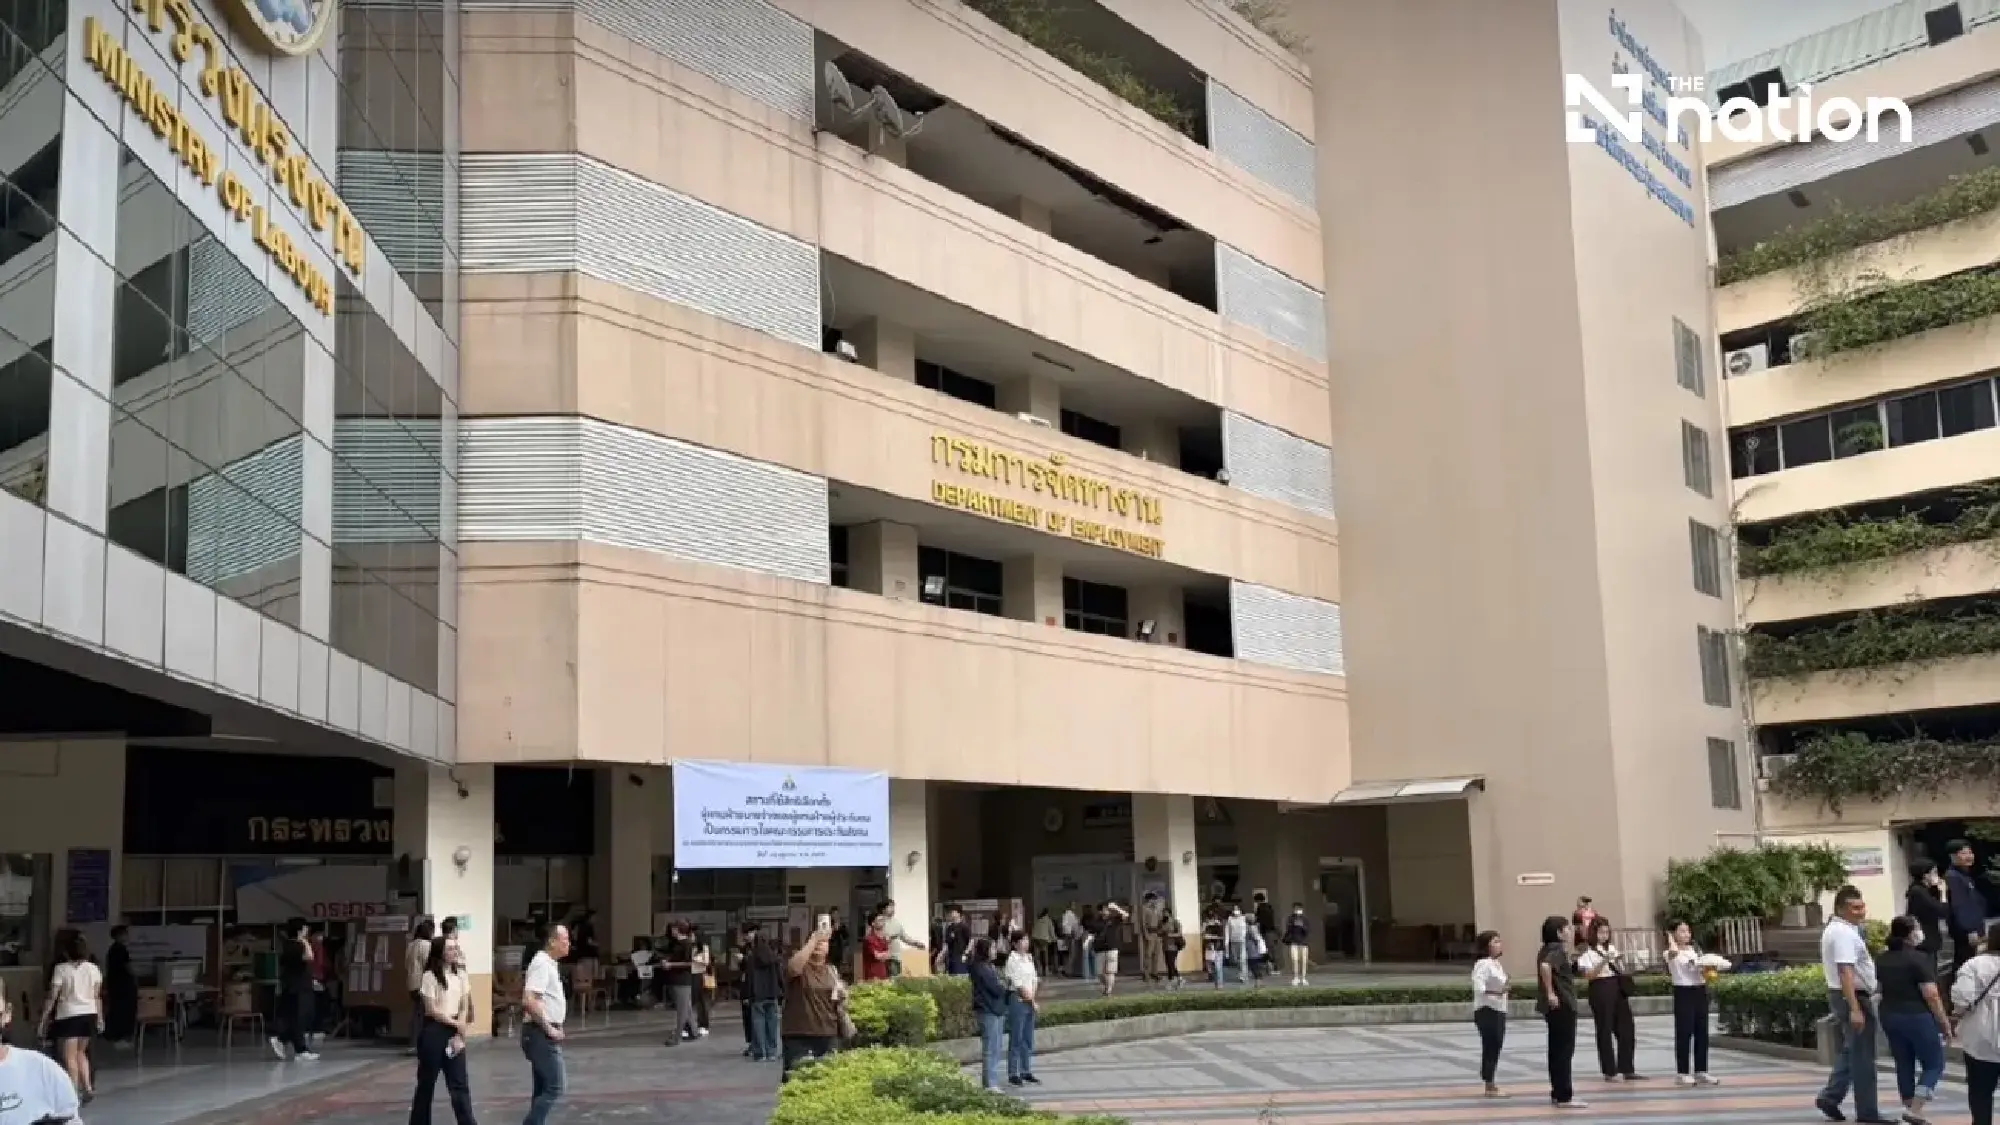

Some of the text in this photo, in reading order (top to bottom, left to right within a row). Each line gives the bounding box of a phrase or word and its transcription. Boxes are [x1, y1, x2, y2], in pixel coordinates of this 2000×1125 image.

[84, 16, 334, 318] MINISTRY OF LABOUR
[931, 477, 1166, 558] DEPARTMENT OF EMPLOYMENT
